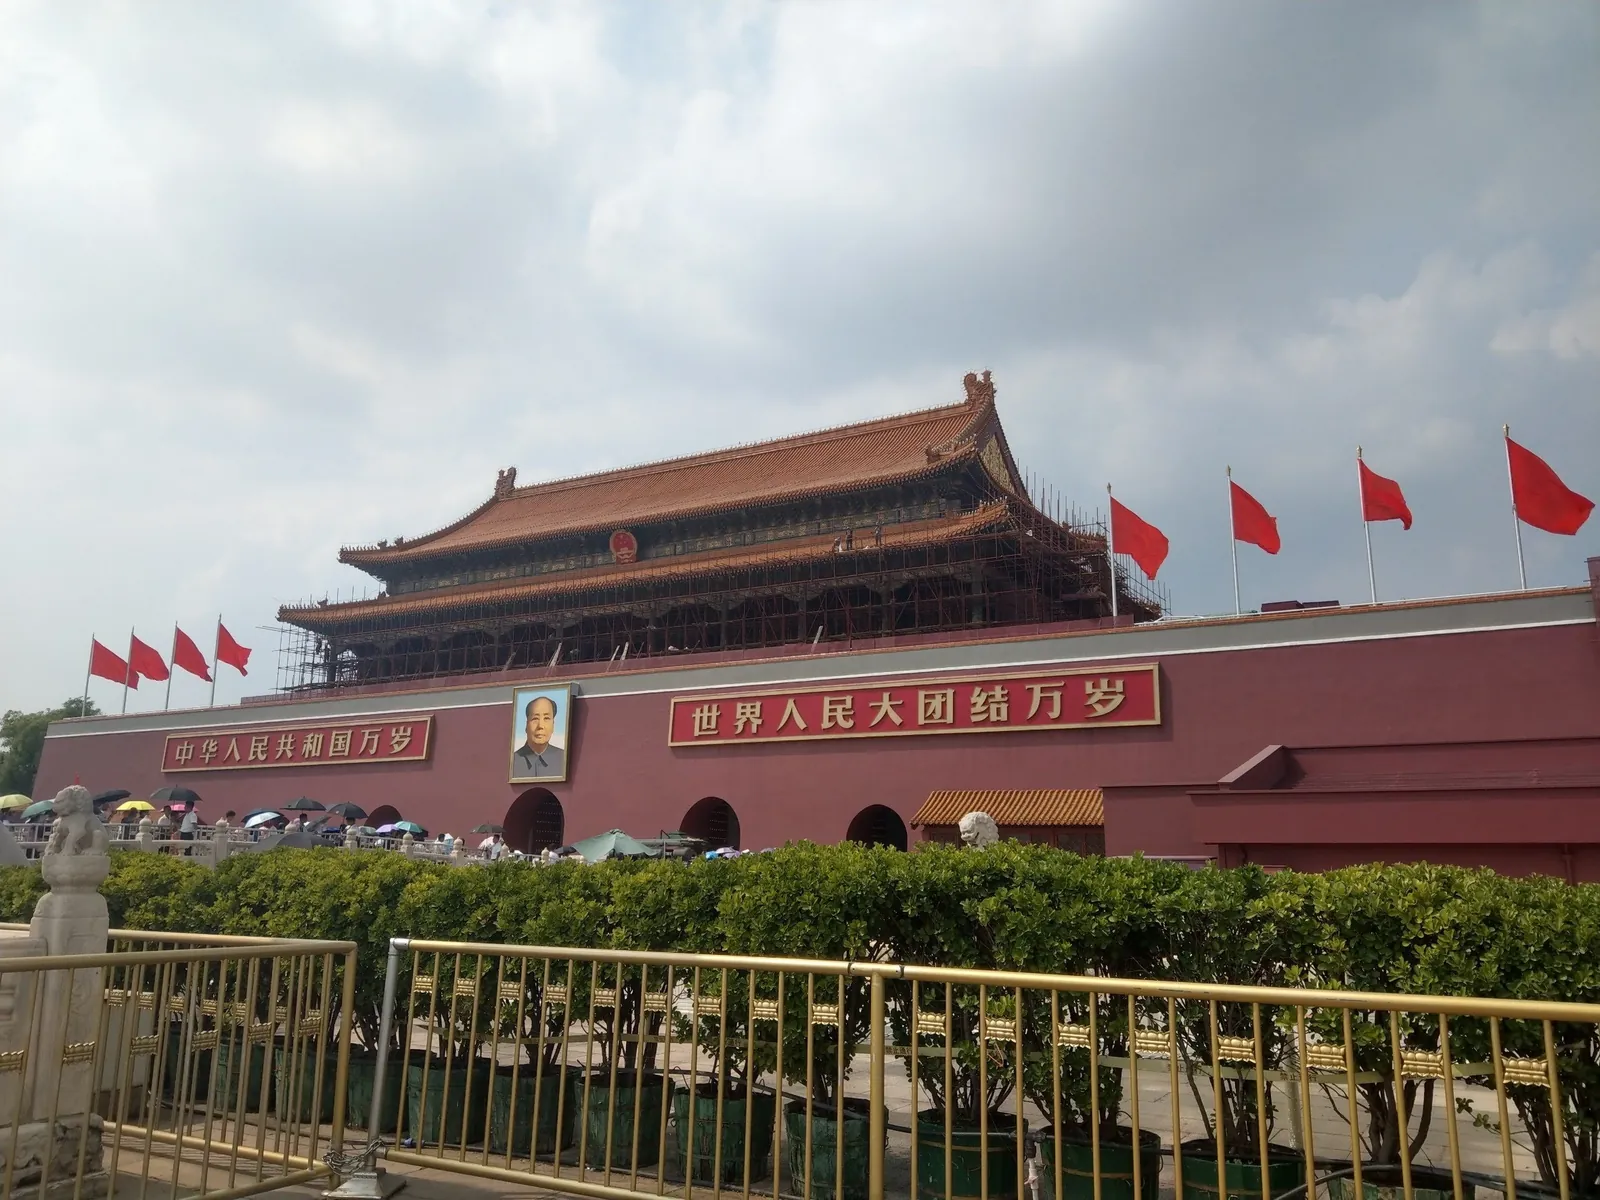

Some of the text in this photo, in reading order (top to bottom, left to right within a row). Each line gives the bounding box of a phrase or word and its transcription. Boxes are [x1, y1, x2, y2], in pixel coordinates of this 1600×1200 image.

[691, 678, 1126, 737] 世界人民大团结万岁
[175, 725, 413, 765] 中华人民共和国万岁
